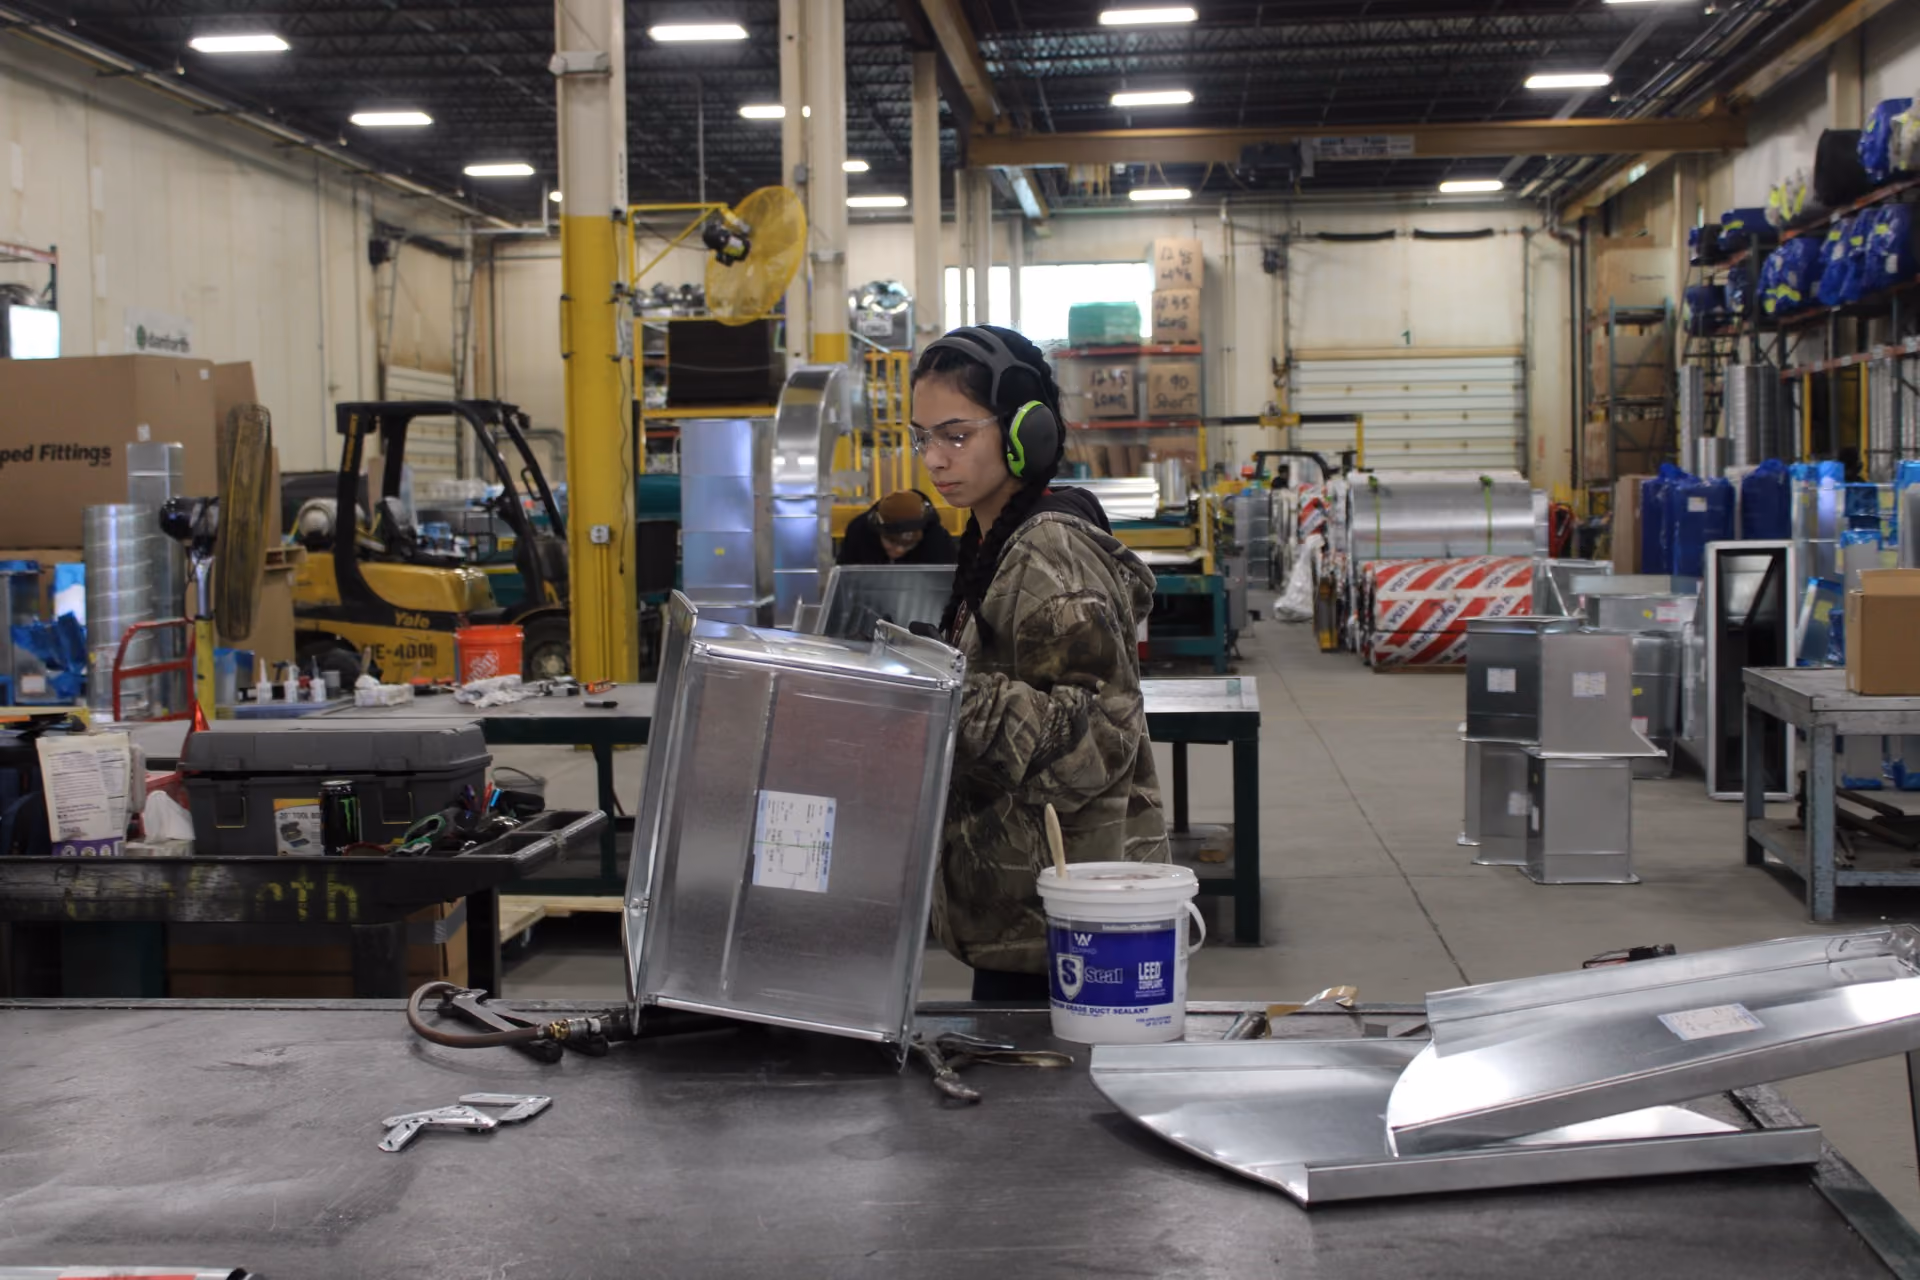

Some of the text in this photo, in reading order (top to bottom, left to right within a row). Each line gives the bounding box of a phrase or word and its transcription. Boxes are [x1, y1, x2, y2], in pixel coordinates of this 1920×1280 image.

[1401, 329, 1411, 345] 1
[40, 443, 111, 467] Fittings
[394, 612, 431, 629] Yale
[1089, 1007, 1111, 1015] DUCT
[1112, 1006, 1149, 1015] SEALANT
